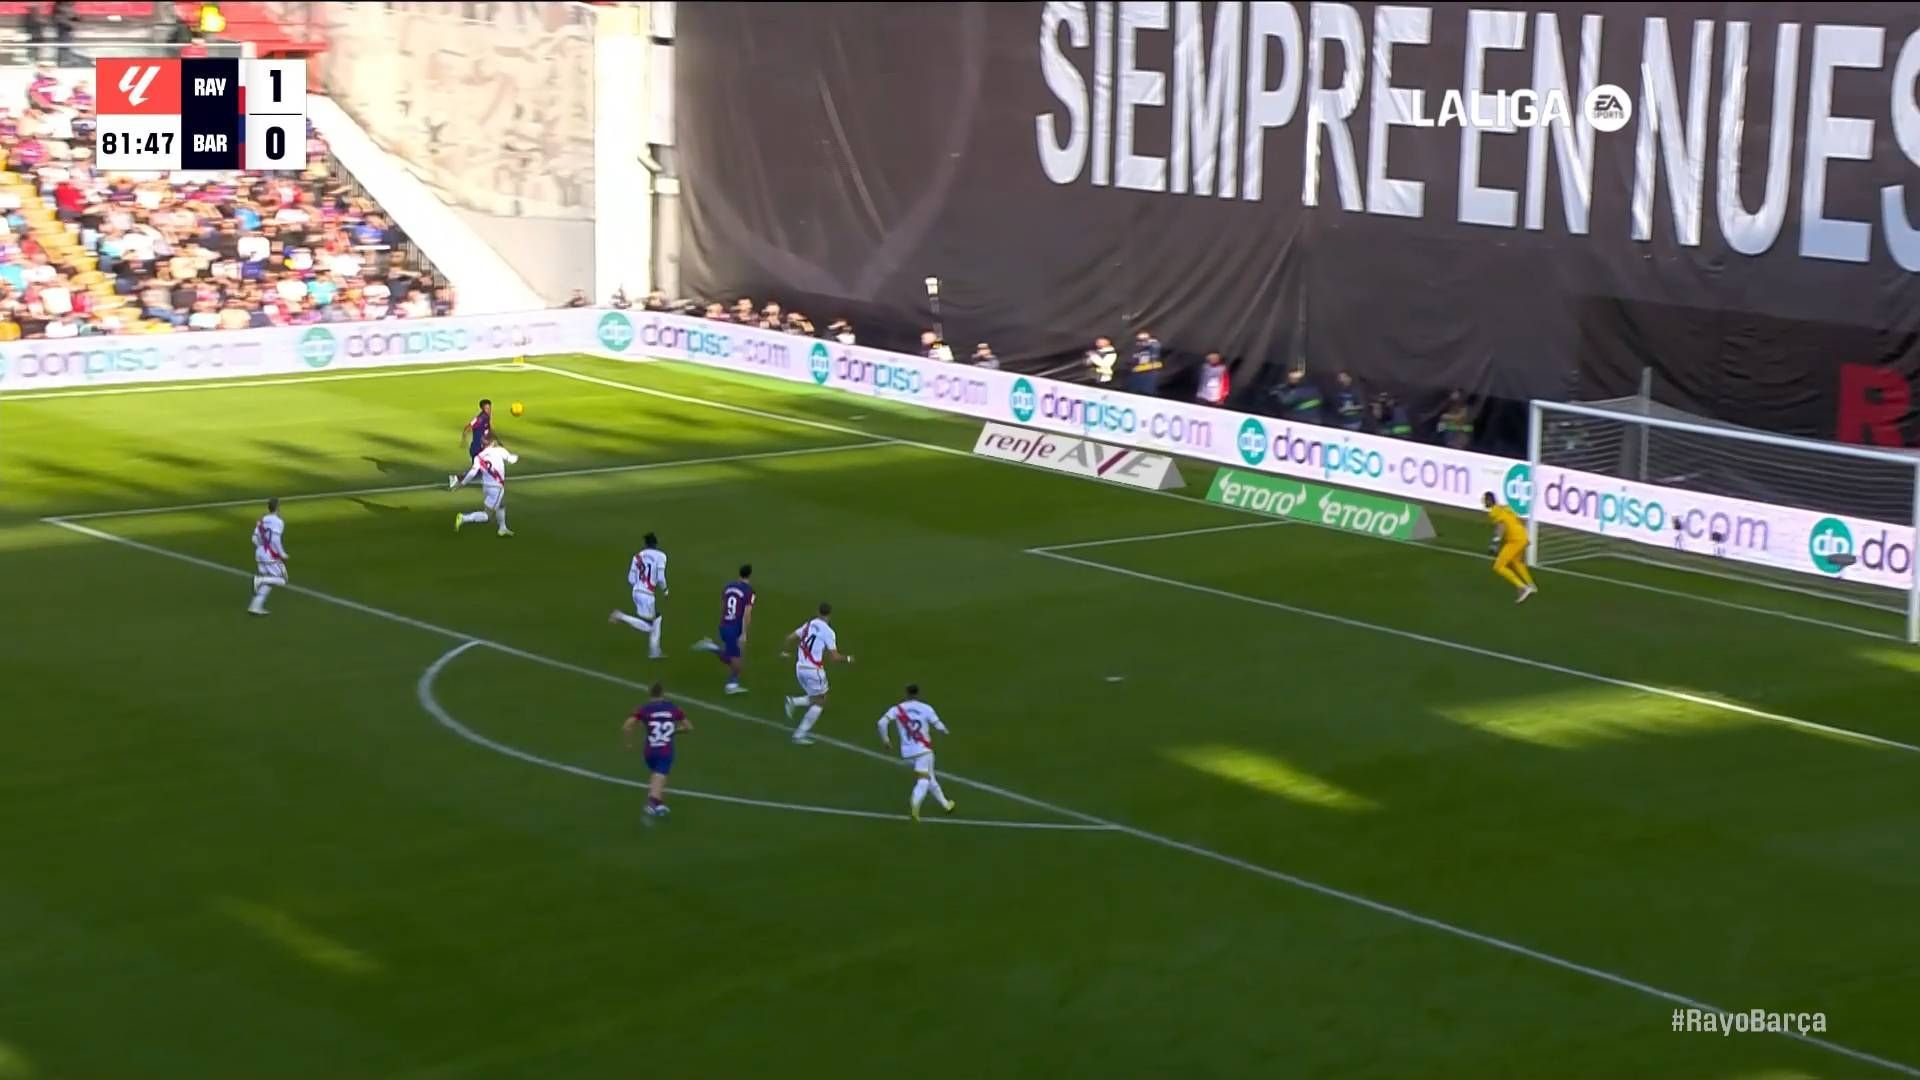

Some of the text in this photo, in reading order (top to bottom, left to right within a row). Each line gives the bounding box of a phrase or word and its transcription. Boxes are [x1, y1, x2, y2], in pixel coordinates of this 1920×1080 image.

[1035, 1, 1432, 218] SIEMPRE
[1457, 9, 1604, 234] EN
[985, 432, 1164, 477] renfe AVE
[727, 595, 737, 615] 9
[648, 721, 675, 742] 32
